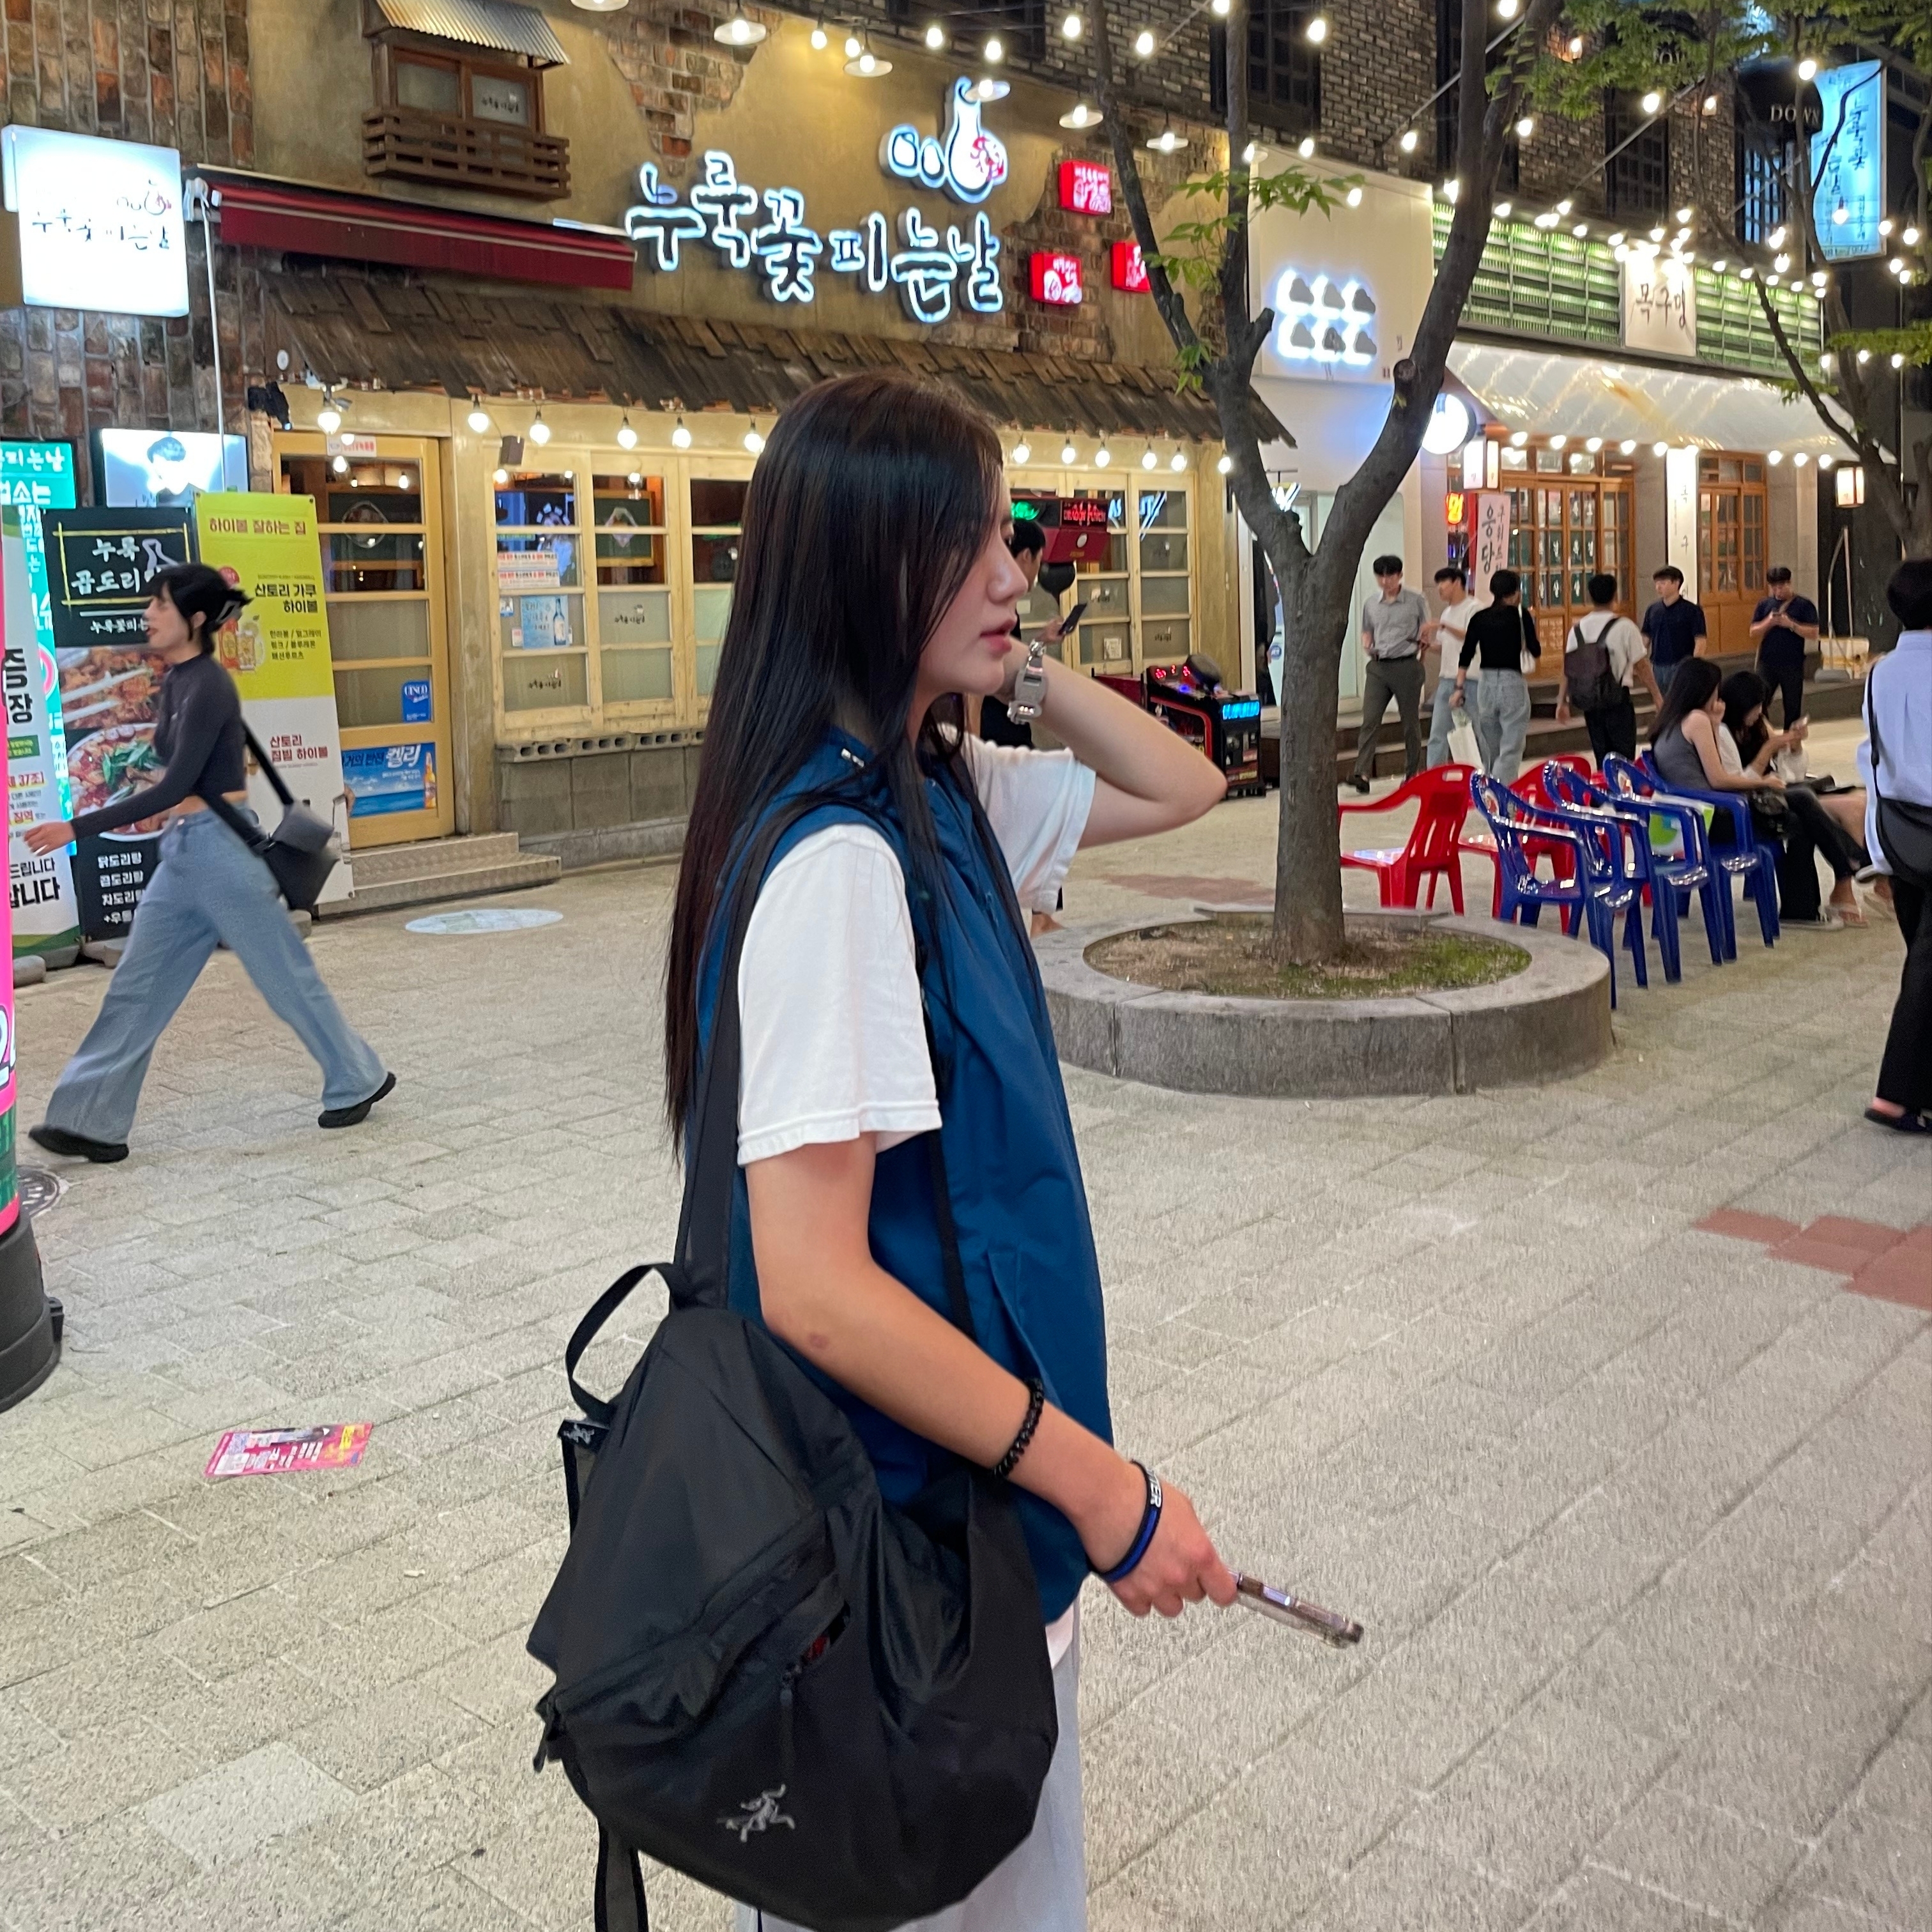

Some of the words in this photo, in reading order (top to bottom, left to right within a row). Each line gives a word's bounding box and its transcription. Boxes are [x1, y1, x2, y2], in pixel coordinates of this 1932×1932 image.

[625, 150, 1004, 324] 누룩꽃피는날
[1635, 280, 1685, 330] 목구멍
[93, 536, 140, 562] 누룩
[255, 583, 290, 597] 산토리
[270, 734, 302, 748] 산토리
